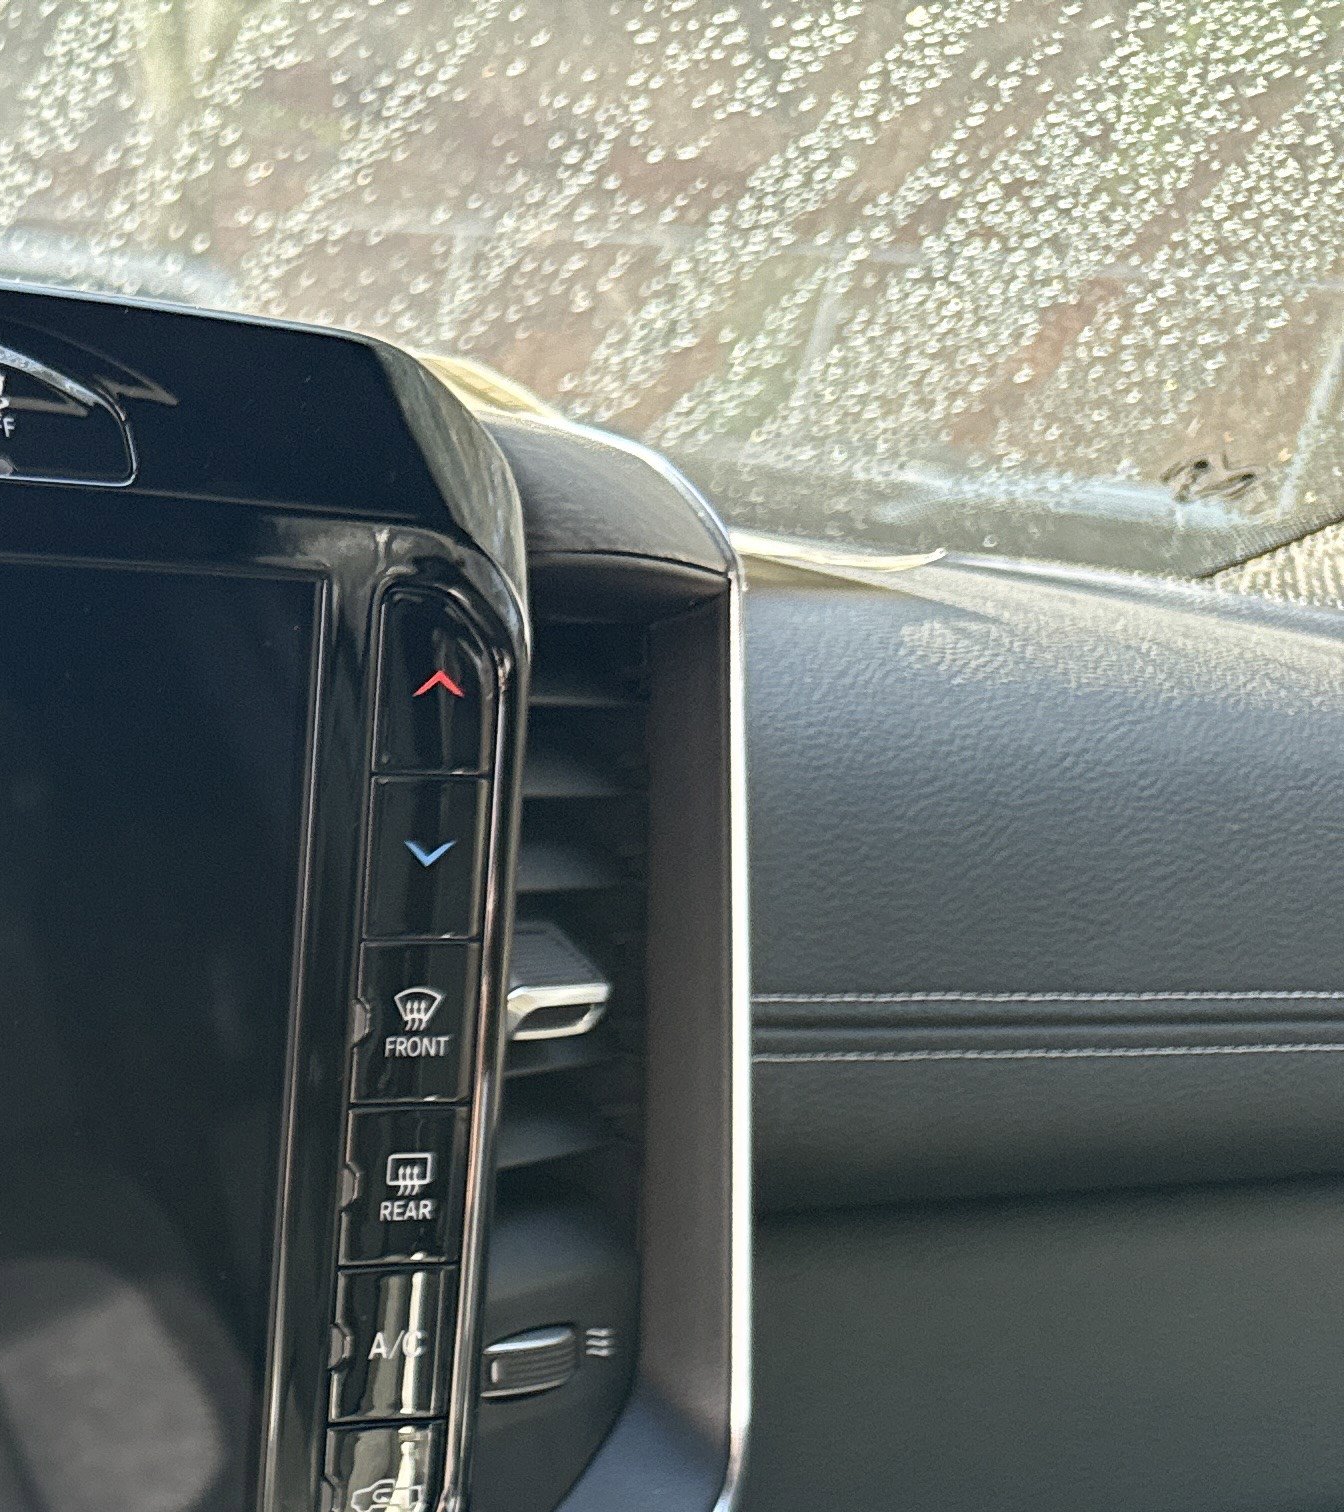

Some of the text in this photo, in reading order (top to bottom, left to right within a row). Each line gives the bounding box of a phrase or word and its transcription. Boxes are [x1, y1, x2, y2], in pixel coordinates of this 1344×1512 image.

[384, 1036, 450, 1059] FRONT
[380, 1201, 433, 1221] REAR
[367, 1330, 426, 1359] A/C
